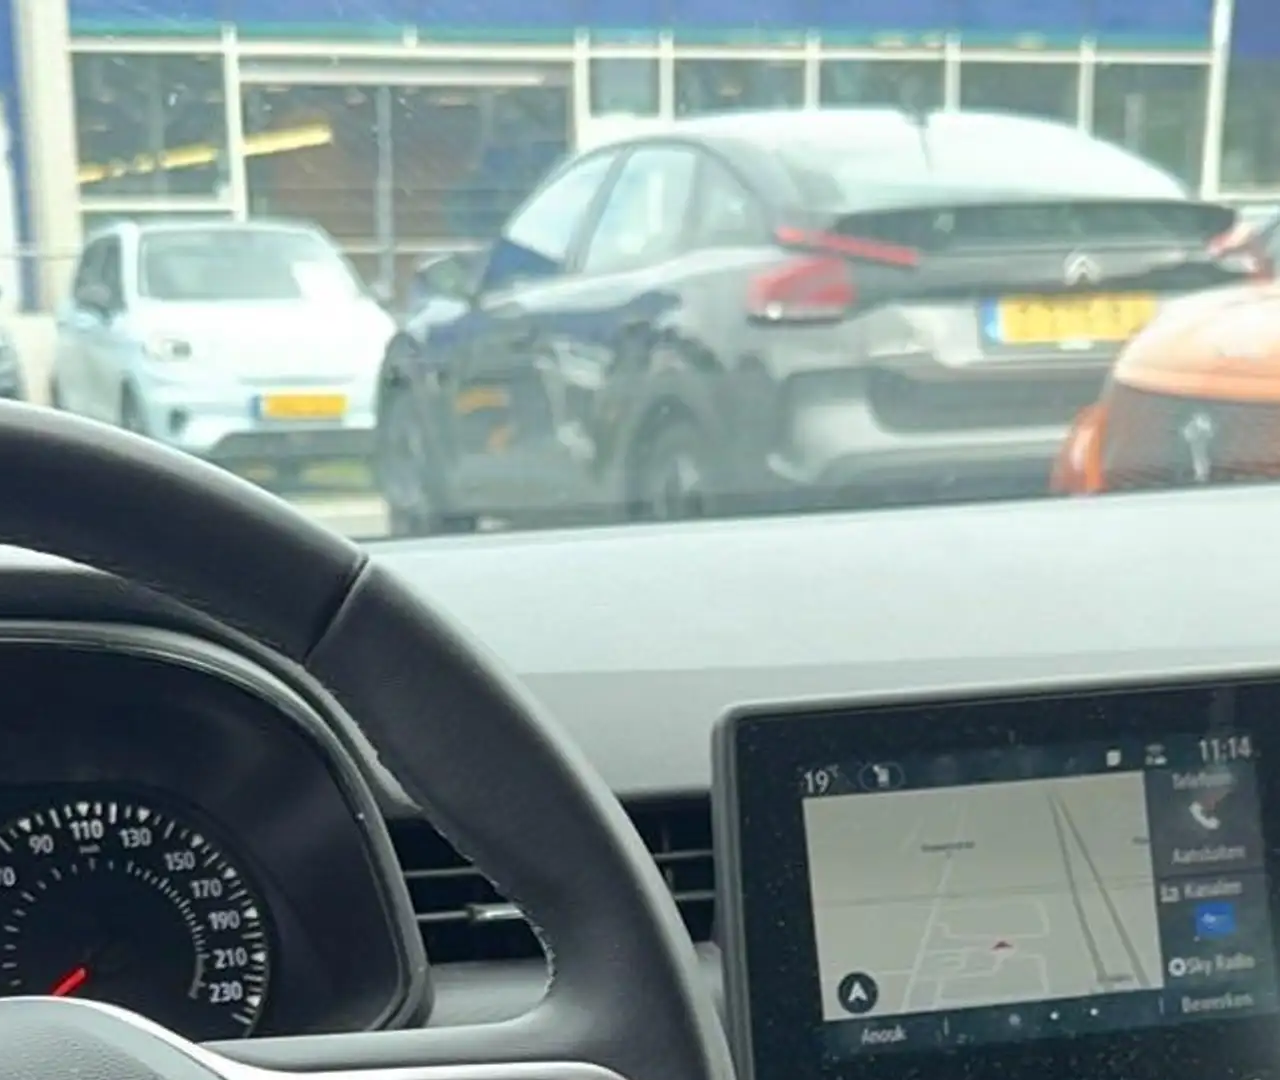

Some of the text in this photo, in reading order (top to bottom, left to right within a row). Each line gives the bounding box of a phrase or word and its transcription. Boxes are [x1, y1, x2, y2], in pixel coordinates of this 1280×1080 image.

[1199, 736, 1252, 762] 11:14
[69, 819, 104, 840] 110
[119, 827, 153, 848] 130
[28, 833, 54, 854] 90
[163, 851, 196, 871] 150
[190, 878, 223, 898] 170
[208, 910, 240, 931] 190
[213, 947, 248, 969] 210
[208, 981, 243, 1003] 230
[861, 1024, 907, 1045] Anouk
